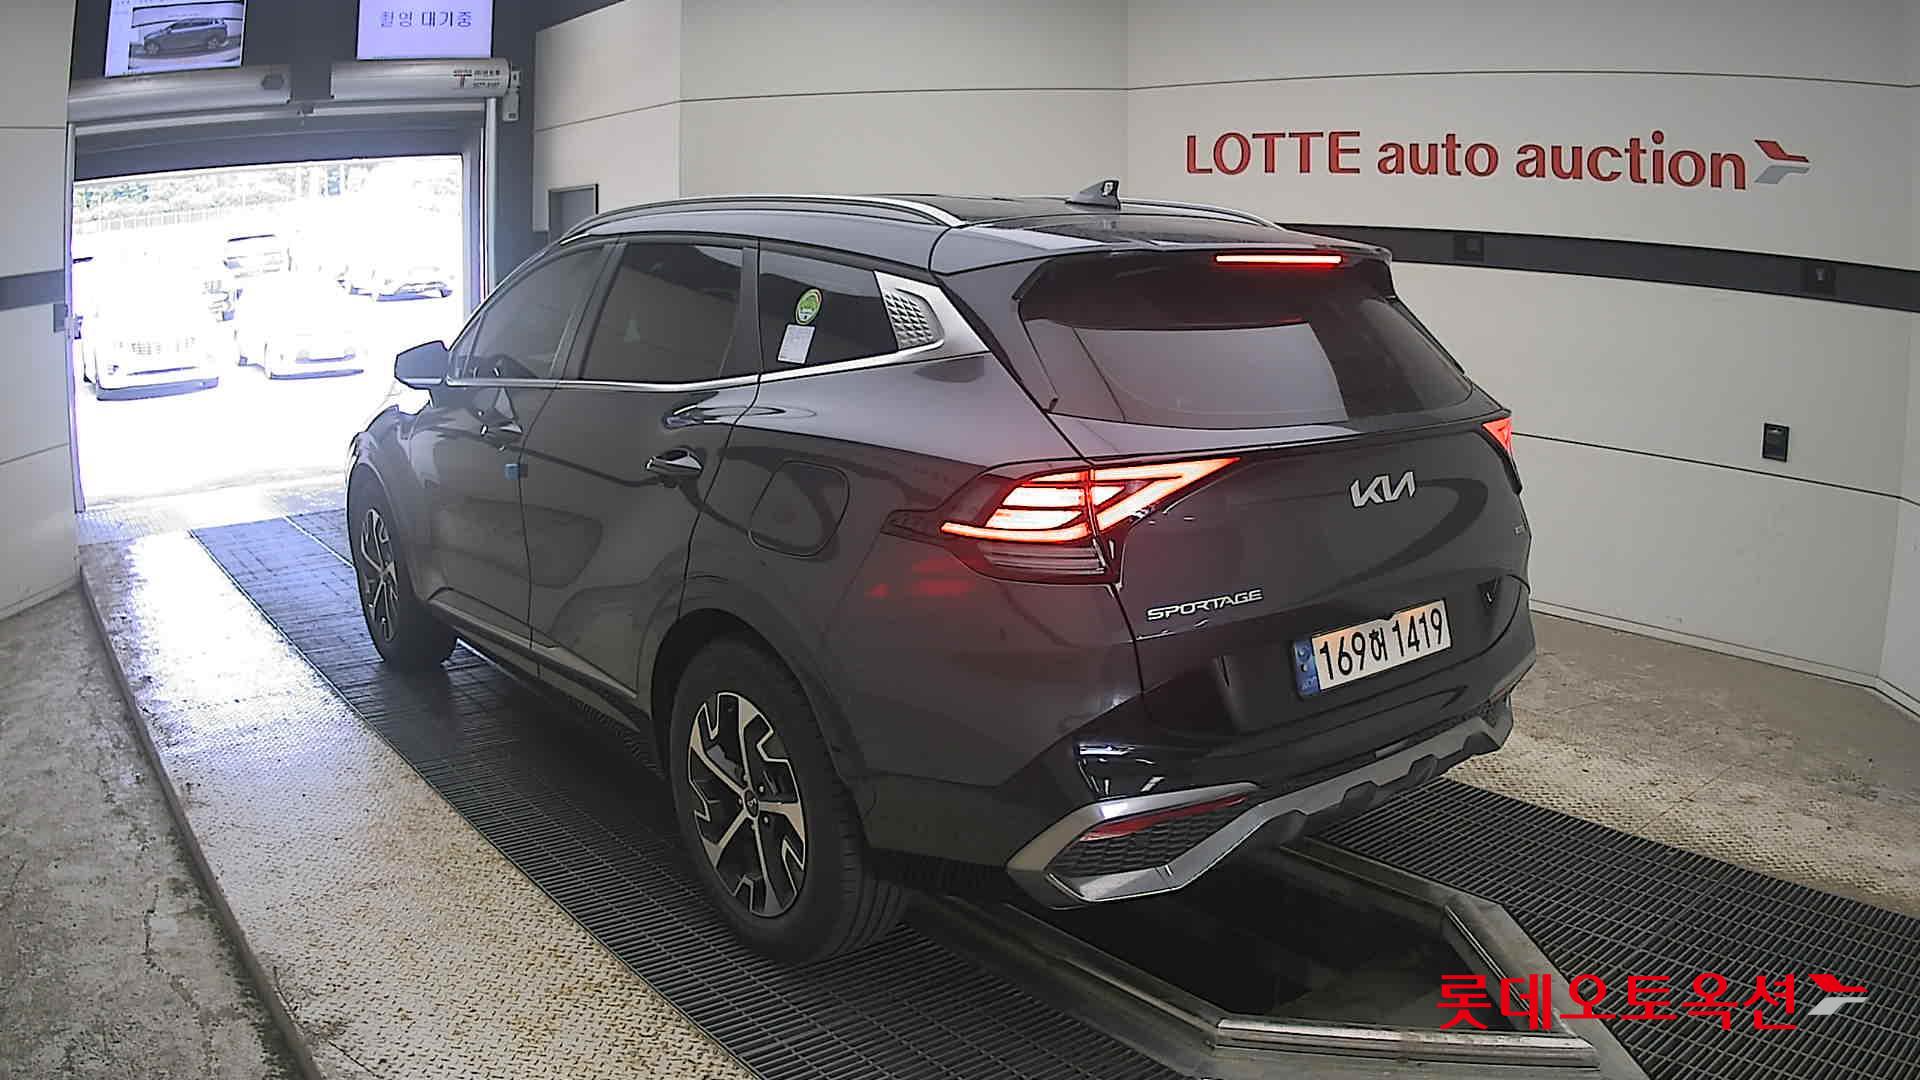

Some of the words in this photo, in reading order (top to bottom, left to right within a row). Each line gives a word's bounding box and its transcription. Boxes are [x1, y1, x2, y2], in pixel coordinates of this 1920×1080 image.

[421, 11, 472, 27] 대기중
[1186, 131, 1360, 175] LOTTE
[1378, 134, 1499, 177] auto
[1516, 131, 1747, 189] auction
[1350, 471, 1416, 507] KIA
[1147, 589, 1263, 621] SPORTAGE
